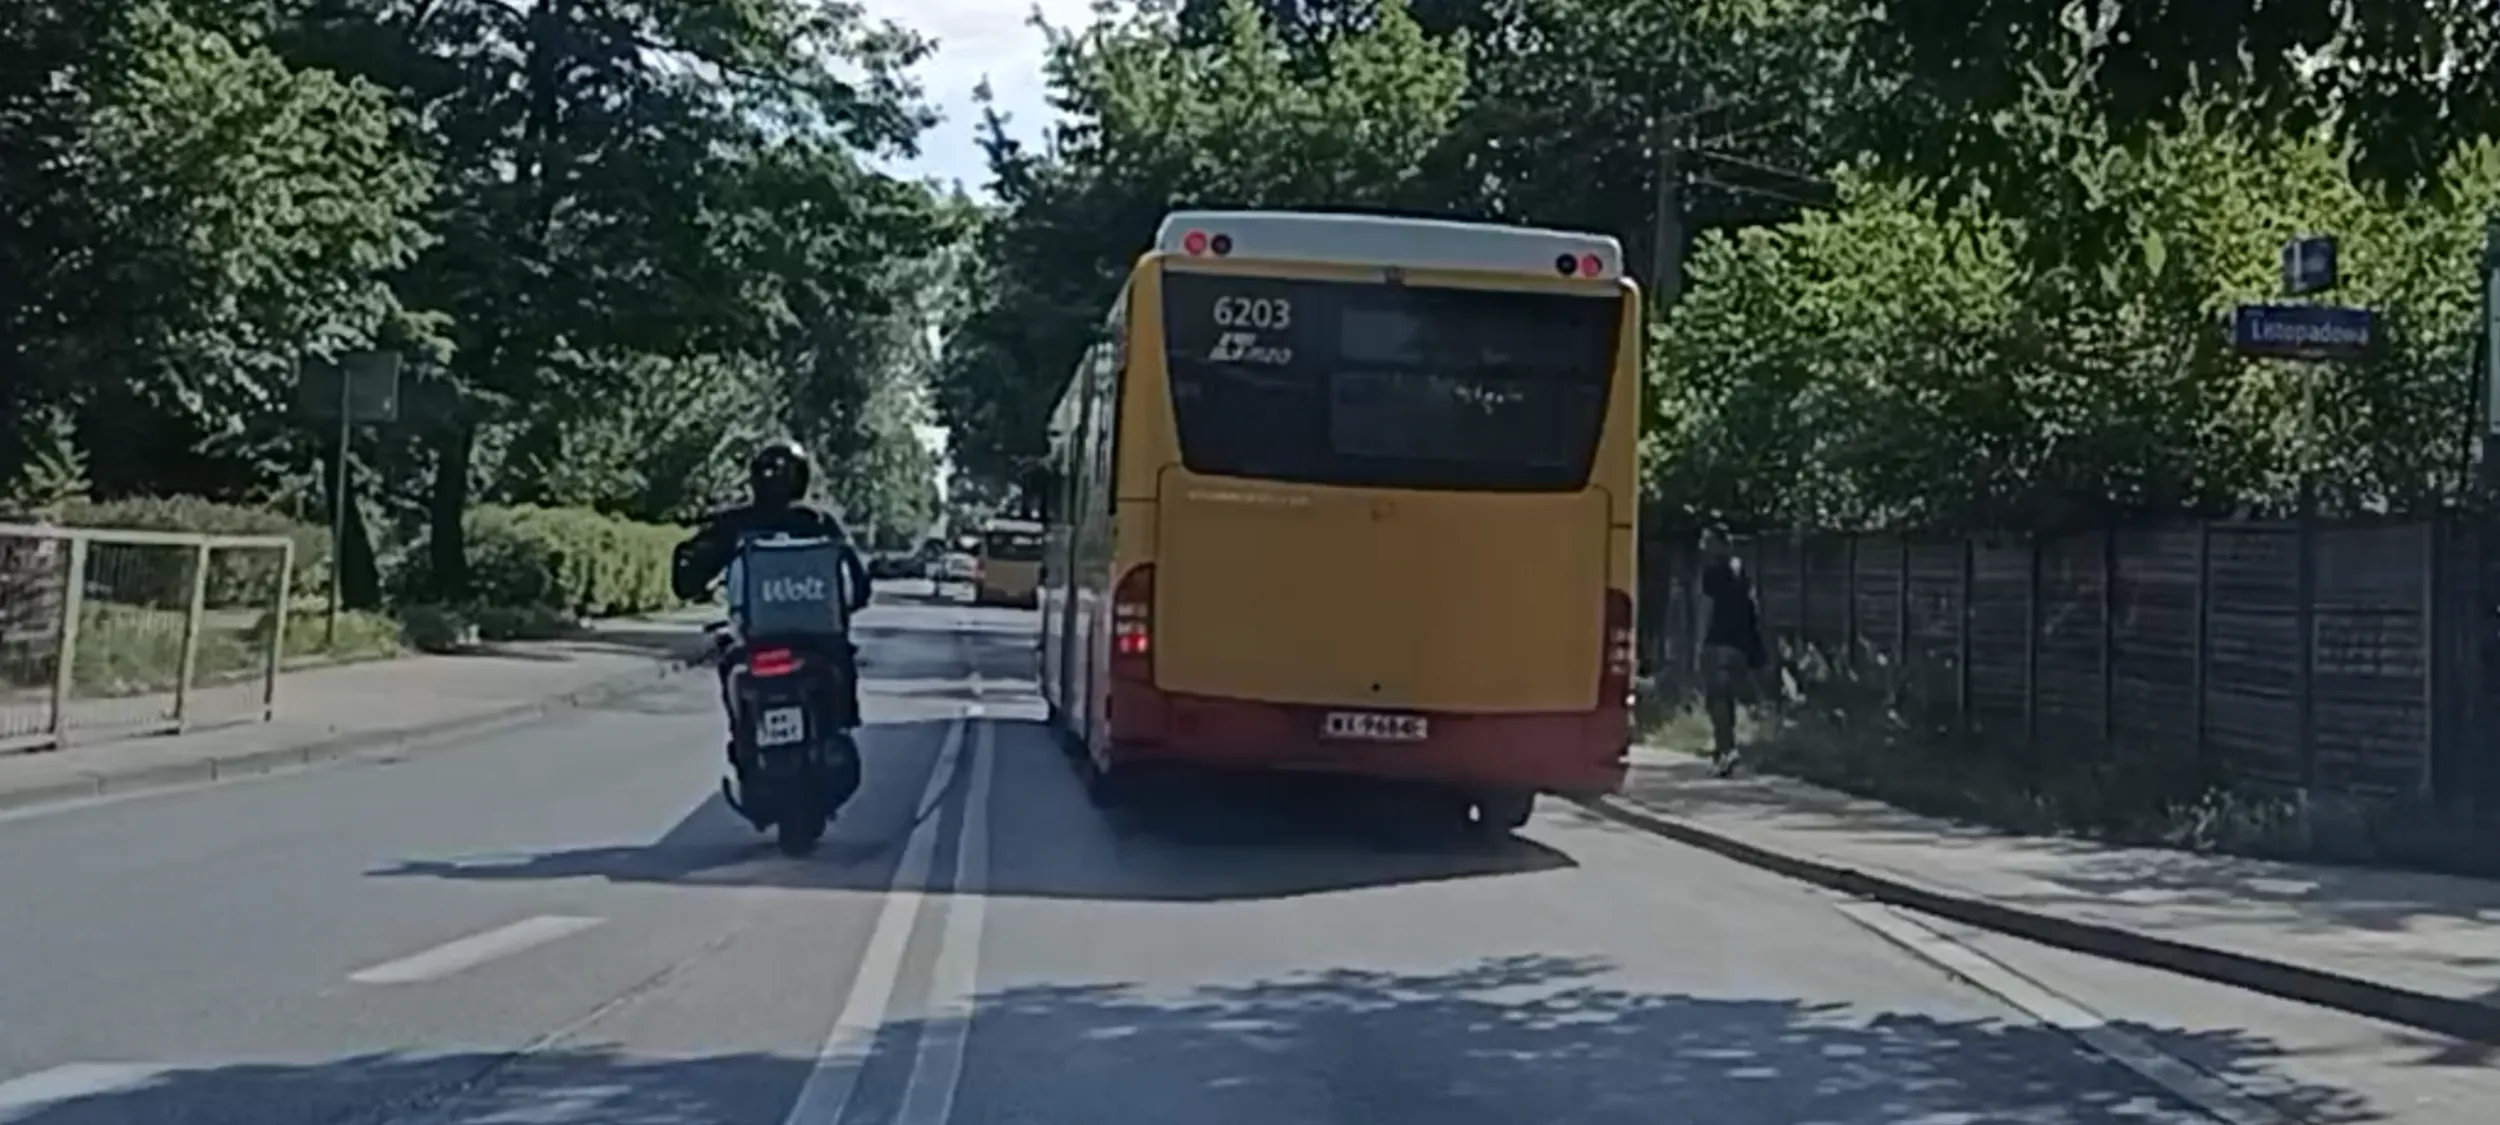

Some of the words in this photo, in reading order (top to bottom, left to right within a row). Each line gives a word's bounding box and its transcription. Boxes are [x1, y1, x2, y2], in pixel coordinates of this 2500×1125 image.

[1213, 296, 1291, 329] 6203
[2251, 318, 2369, 347] Listopadowa
[763, 576, 825, 602] Wolt
